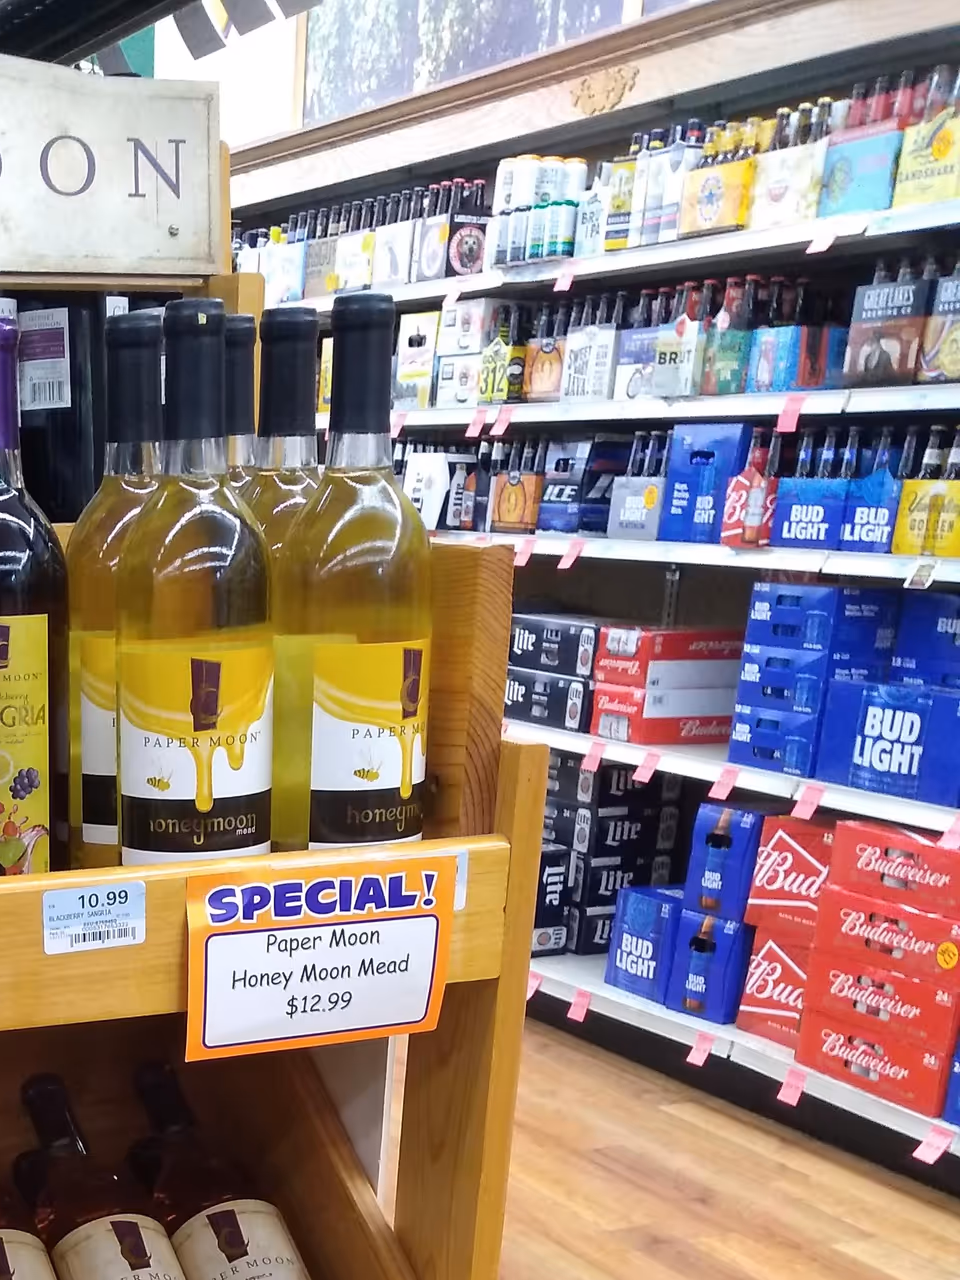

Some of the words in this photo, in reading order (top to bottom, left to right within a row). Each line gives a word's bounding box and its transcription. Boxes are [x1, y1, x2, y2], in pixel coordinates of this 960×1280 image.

[480, 363, 508, 395] 312
[543, 484, 578, 502] ICE
[620, 508, 647, 521] LIGHT
[790, 504, 825, 523] BUD
[854, 506, 890, 525] BUD
[782, 521, 830, 541] LIGHT
[843, 523, 892, 544] LIGHT
[750, 610, 772, 622] LIGHT
[513, 627, 537, 655] Lite
[3, 672, 39, 682] MOON
[740, 671, 762, 683] LIGHT
[597, 694, 639, 715] Budweiser
[351, 725, 406, 740] PAPER
[863, 705, 922, 745] BUD
[143, 736, 200, 748] PAPER
[209, 731, 258, 747] MOON
[732, 731, 753, 744] LIGHT
[852, 735, 924, 777] LIGHT
[604, 821, 642, 848] Lite
[823, 832, 834, 843] 12
[704, 870, 721, 881] BUD
[753, 845, 829, 900] Bud
[856, 843, 951, 888] Budweiser
[542, 863, 567, 906] Lite
[597, 870, 634, 896] Lite
[701, 878, 722, 891] LIGHT
[77, 889, 129, 909] 10.99
[208, 873, 438, 922] SPECIAL!
[48, 912, 85, 922] BLACKBERRY
[87, 908, 113, 919] SANGRIA
[840, 907, 935, 955] Budweiser
[266, 932, 322, 958] Paper
[330, 928, 381, 949] Moon
[621, 932, 654, 960] BUD
[231, 969, 292, 992] Honey
[300, 963, 352, 983] Moon
[358, 953, 410, 976] Mead
[615, 948, 657, 980] LIGHT
[685, 979, 707, 993] LIGHT
[688, 973, 706, 985] BUD
[829, 968, 921, 1019] Budweiser
[936, 989, 950, 1003] 24
[285, 991, 353, 1018] $12.99
[821, 1028, 909, 1081] Budweiser
[923, 1052, 937, 1066] 24
[246, 1255, 295, 1269] MOON
